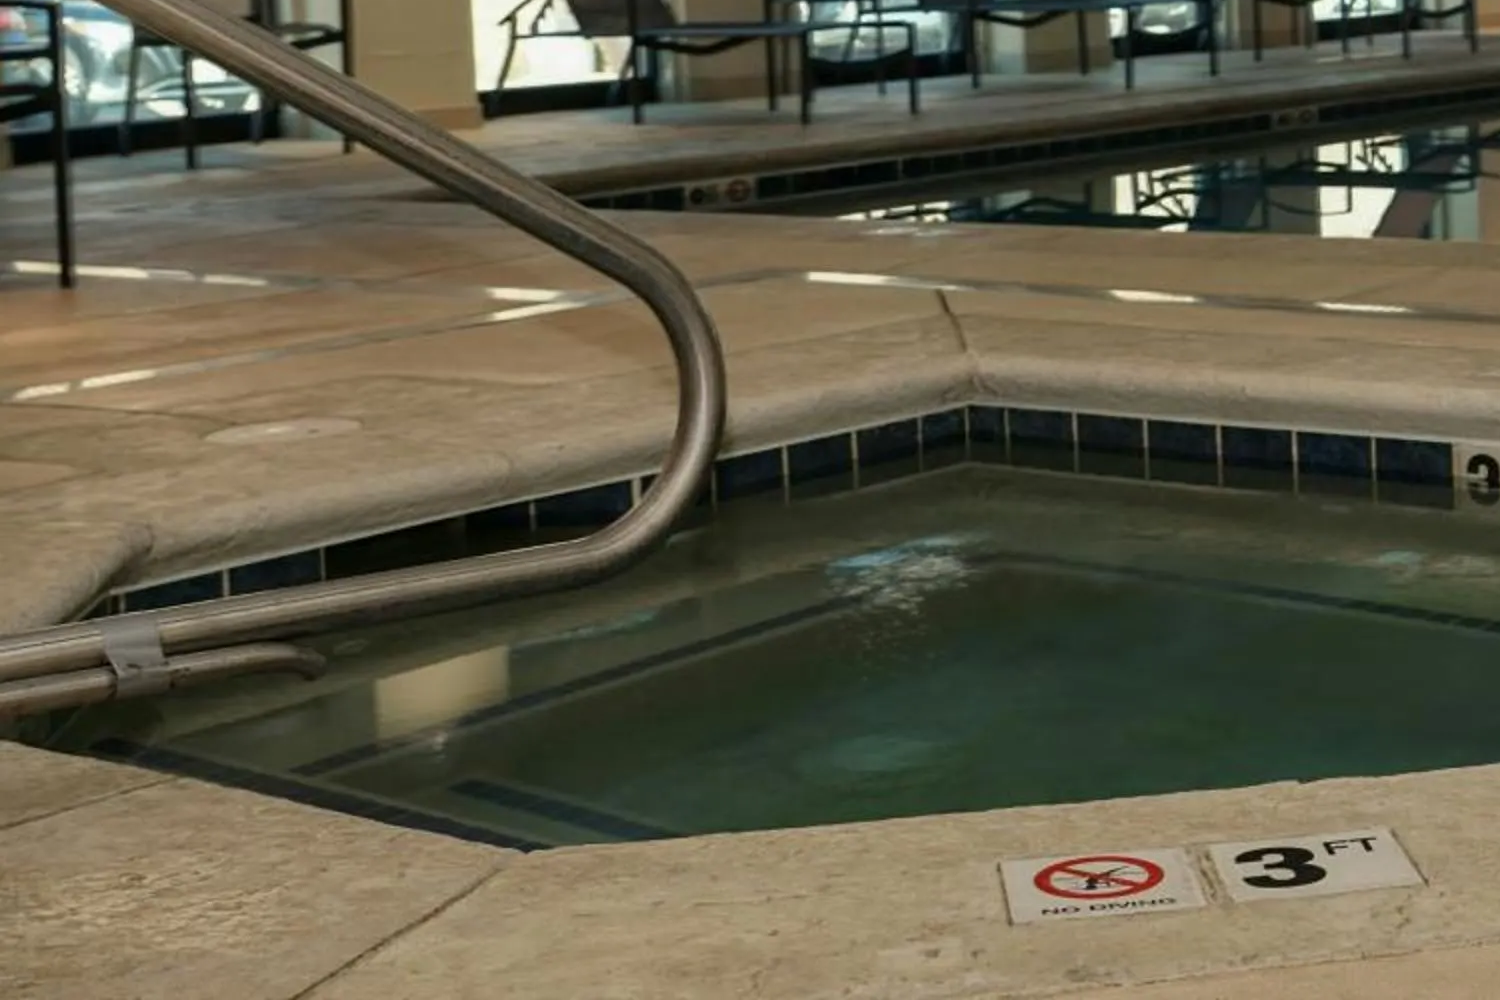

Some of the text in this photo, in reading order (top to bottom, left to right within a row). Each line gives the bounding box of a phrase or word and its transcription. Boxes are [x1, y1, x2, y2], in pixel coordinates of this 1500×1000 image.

[1234, 836, 1377, 889] 3 FT
[1041, 896, 1178, 917] NO DIVING
